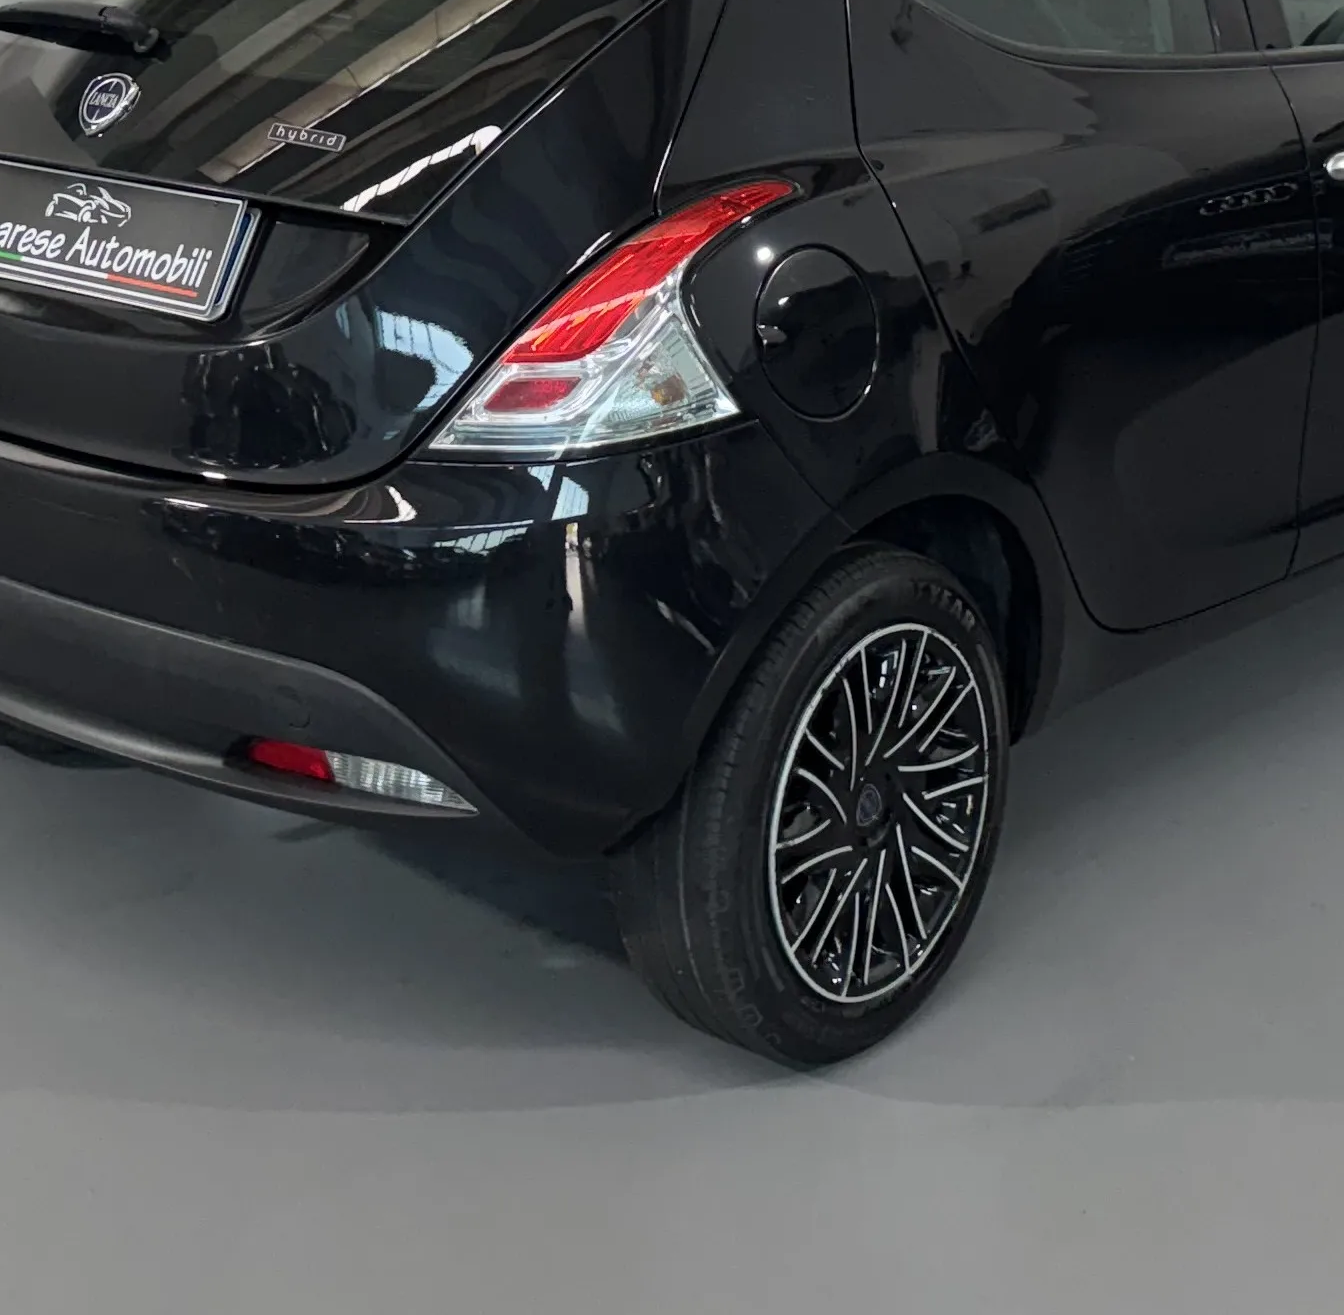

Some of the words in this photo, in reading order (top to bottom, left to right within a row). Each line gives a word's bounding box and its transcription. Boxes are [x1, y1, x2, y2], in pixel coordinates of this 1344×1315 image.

[89, 91, 119, 109] LANCIA
[274, 125, 338, 147] hybrid
[65, 226, 213, 288] Automobili
